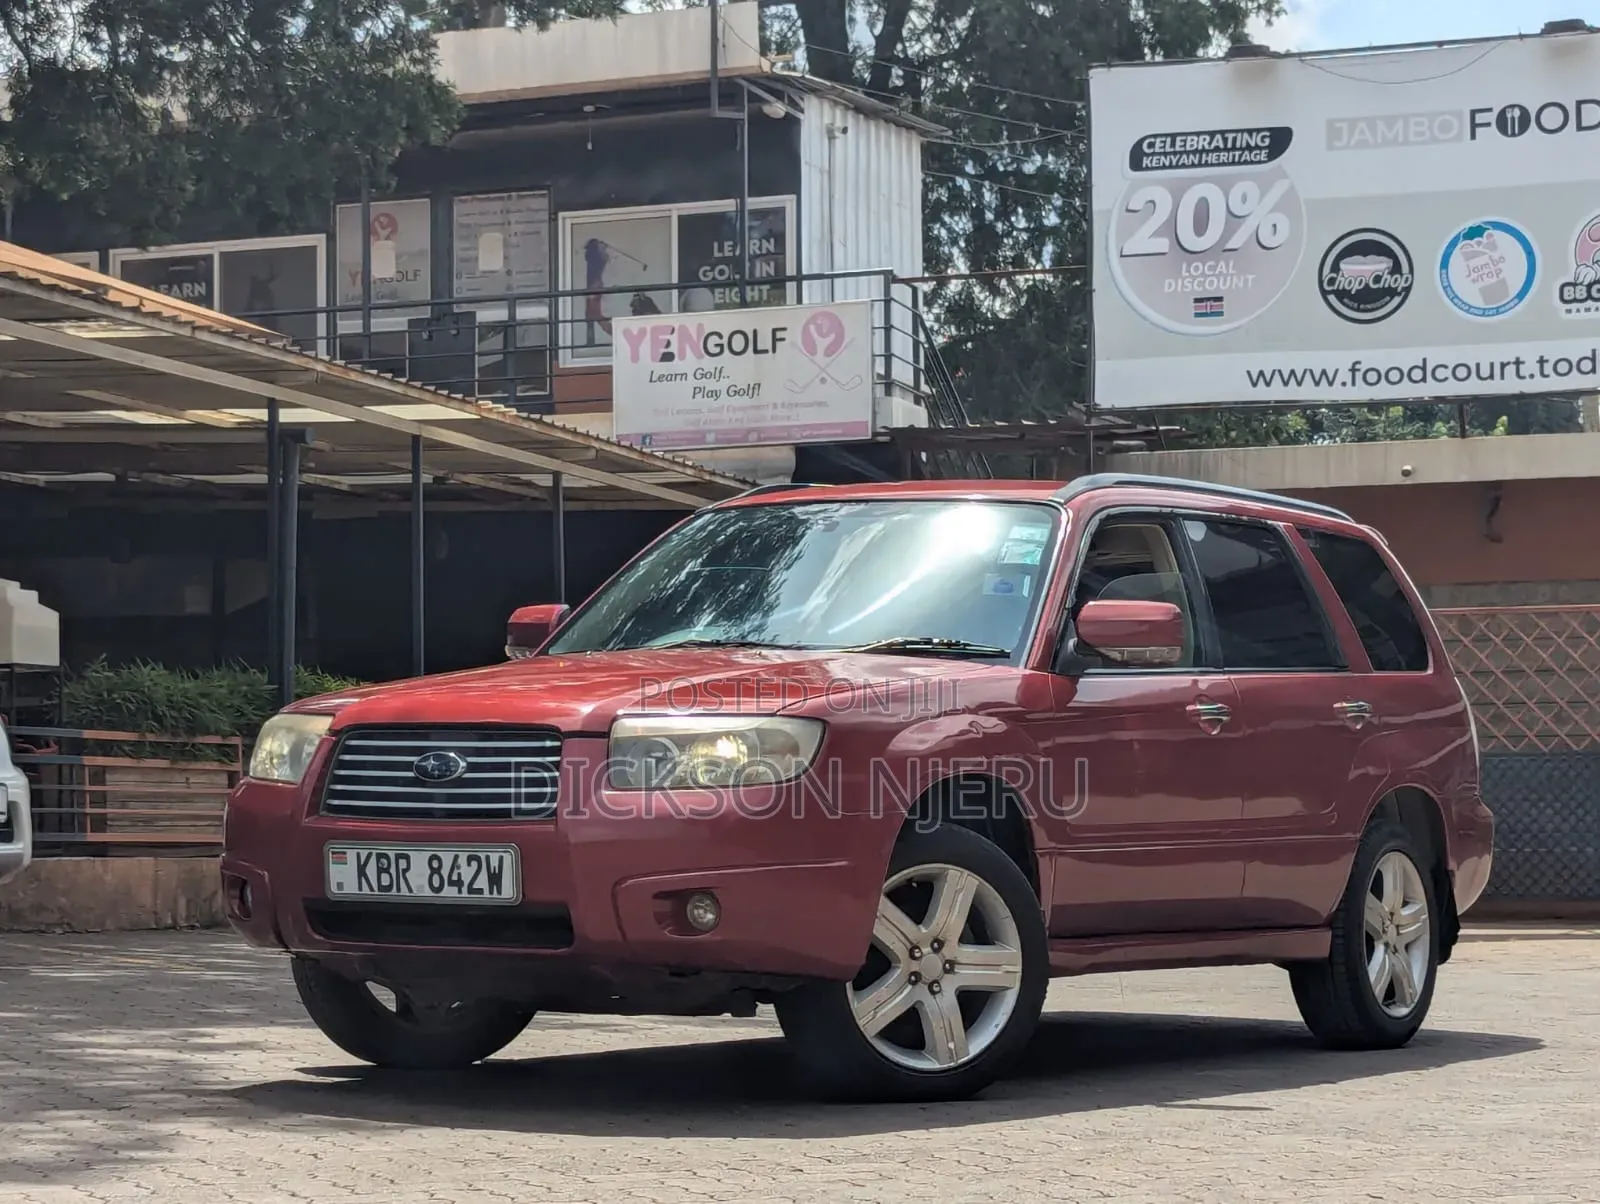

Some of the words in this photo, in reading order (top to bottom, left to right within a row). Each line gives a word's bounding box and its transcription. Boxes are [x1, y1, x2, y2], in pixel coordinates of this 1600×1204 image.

[1332, 114, 1459, 148] JAMBO
[1142, 131, 1271, 154] CELEBRATING
[1142, 152, 1200, 168] KENYAN
[1201, 149, 1269, 165] HERITAGE
[1119, 178, 1291, 258] 20%
[755, 259, 775, 278] IN
[1181, 260, 1237, 277] LOCAL
[1164, 274, 1257, 293] DISCOUNT
[1322, 270, 1366, 295] Chop
[1368, 267, 1412, 293] Chop
[1563, 285, 1588, 300] BB
[649, 370, 688, 383] Learn
[1246, 348, 1597, 388] www.foodcourt.tod
[691, 385, 722, 401] Play
[726, 382, 762, 399] Golf!
[356, 850, 413, 894] KBR
[427, 853, 504, 896] 842W
